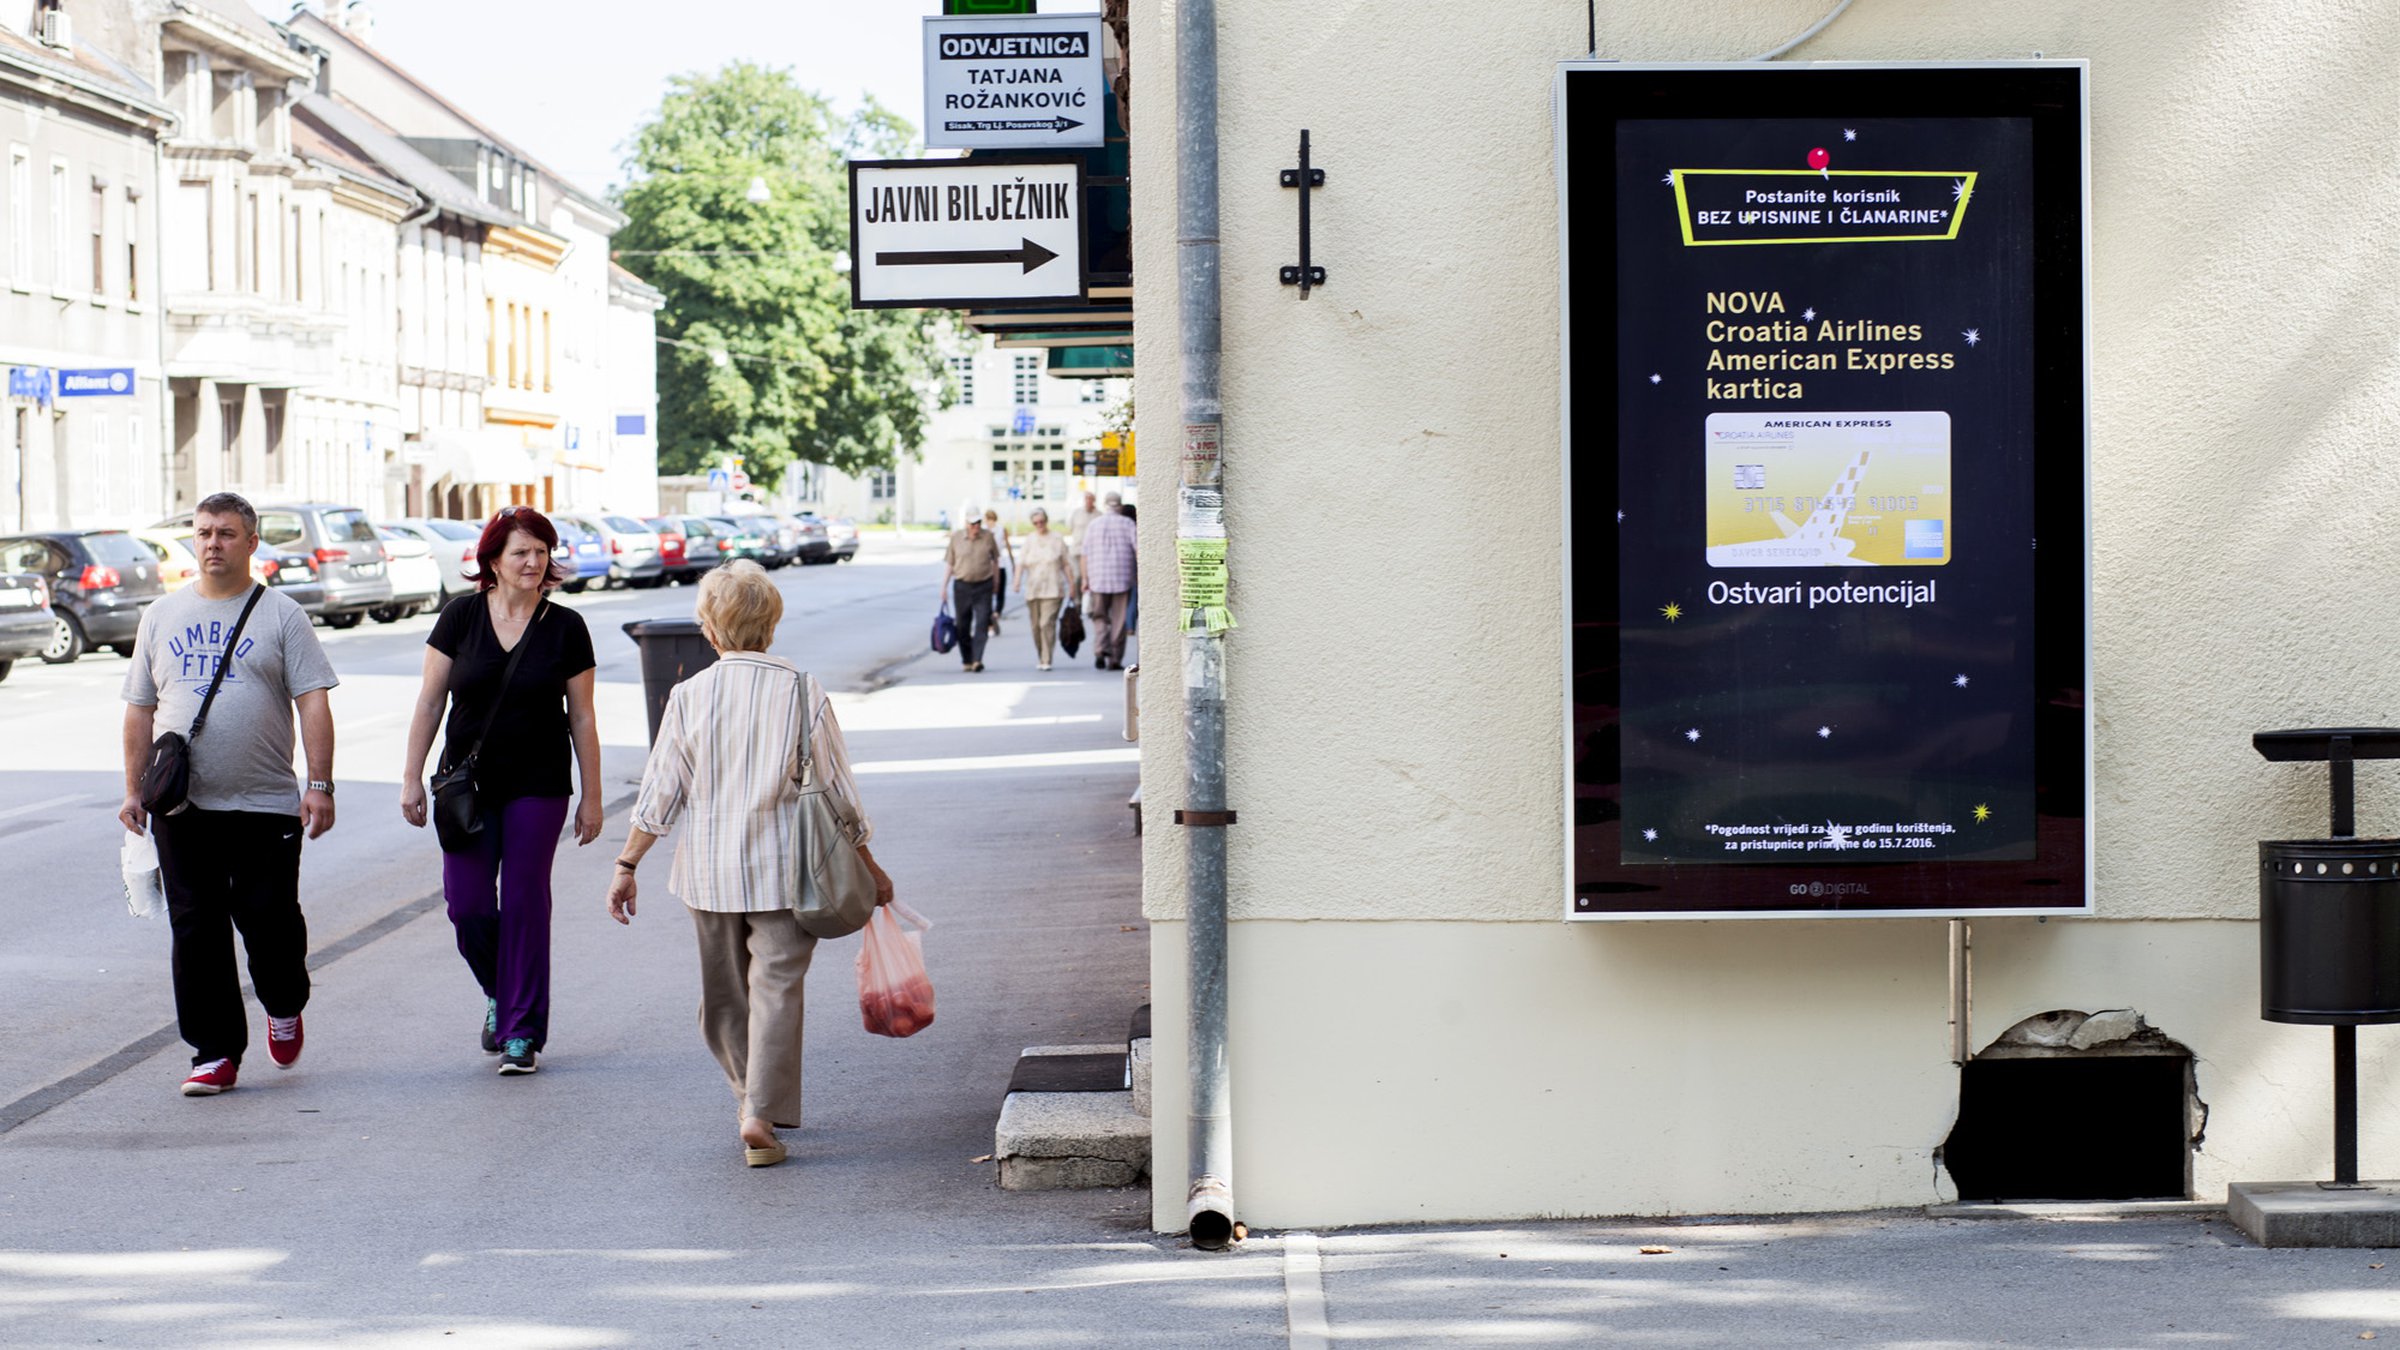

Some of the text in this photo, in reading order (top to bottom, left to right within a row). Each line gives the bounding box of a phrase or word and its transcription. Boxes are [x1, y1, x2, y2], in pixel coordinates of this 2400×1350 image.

[942, 37, 1085, 56] ODVJETNICA
[968, 68, 1063, 84] TATJANA
[945, 87, 1086, 109] ROŽANKOVIĆ
[948, 121, 976, 130] Sisak,
[977, 120, 992, 131] Trg
[1006, 119, 1053, 130] Posavskog
[865, 177, 1070, 224] JAVNI BILJEŽNIK
[1746, 190, 1901, 204] Postanite korisnik
[1698, 211, 1731, 225] BEZ
[1738, 211, 1821, 225] UPISNINE
[1828, 211, 1834, 224] I
[1707, 292, 1786, 314] NOVA
[1706, 320, 1922, 342] Croatia Airlines
[1706, 348, 1955, 375] American Express
[65, 376, 109, 390] Allianz
[1707, 378, 1803, 400] kartica
[1764, 420, 1832, 428] AMERICAN
[1708, 580, 1936, 608] Ostvari potencijal
[1773, 824, 1810, 836] vrijedi
[1811, 826, 1824, 834] za
[1854, 824, 1893, 836] godinu
[1896, 823, 1956, 835] korištenja,
[1725, 841, 1738, 850] za
[1741, 840, 1804, 852] pristupnice
[1862, 839, 1876, 849] do
[1879, 838, 1936, 849] 15.7.2016.
